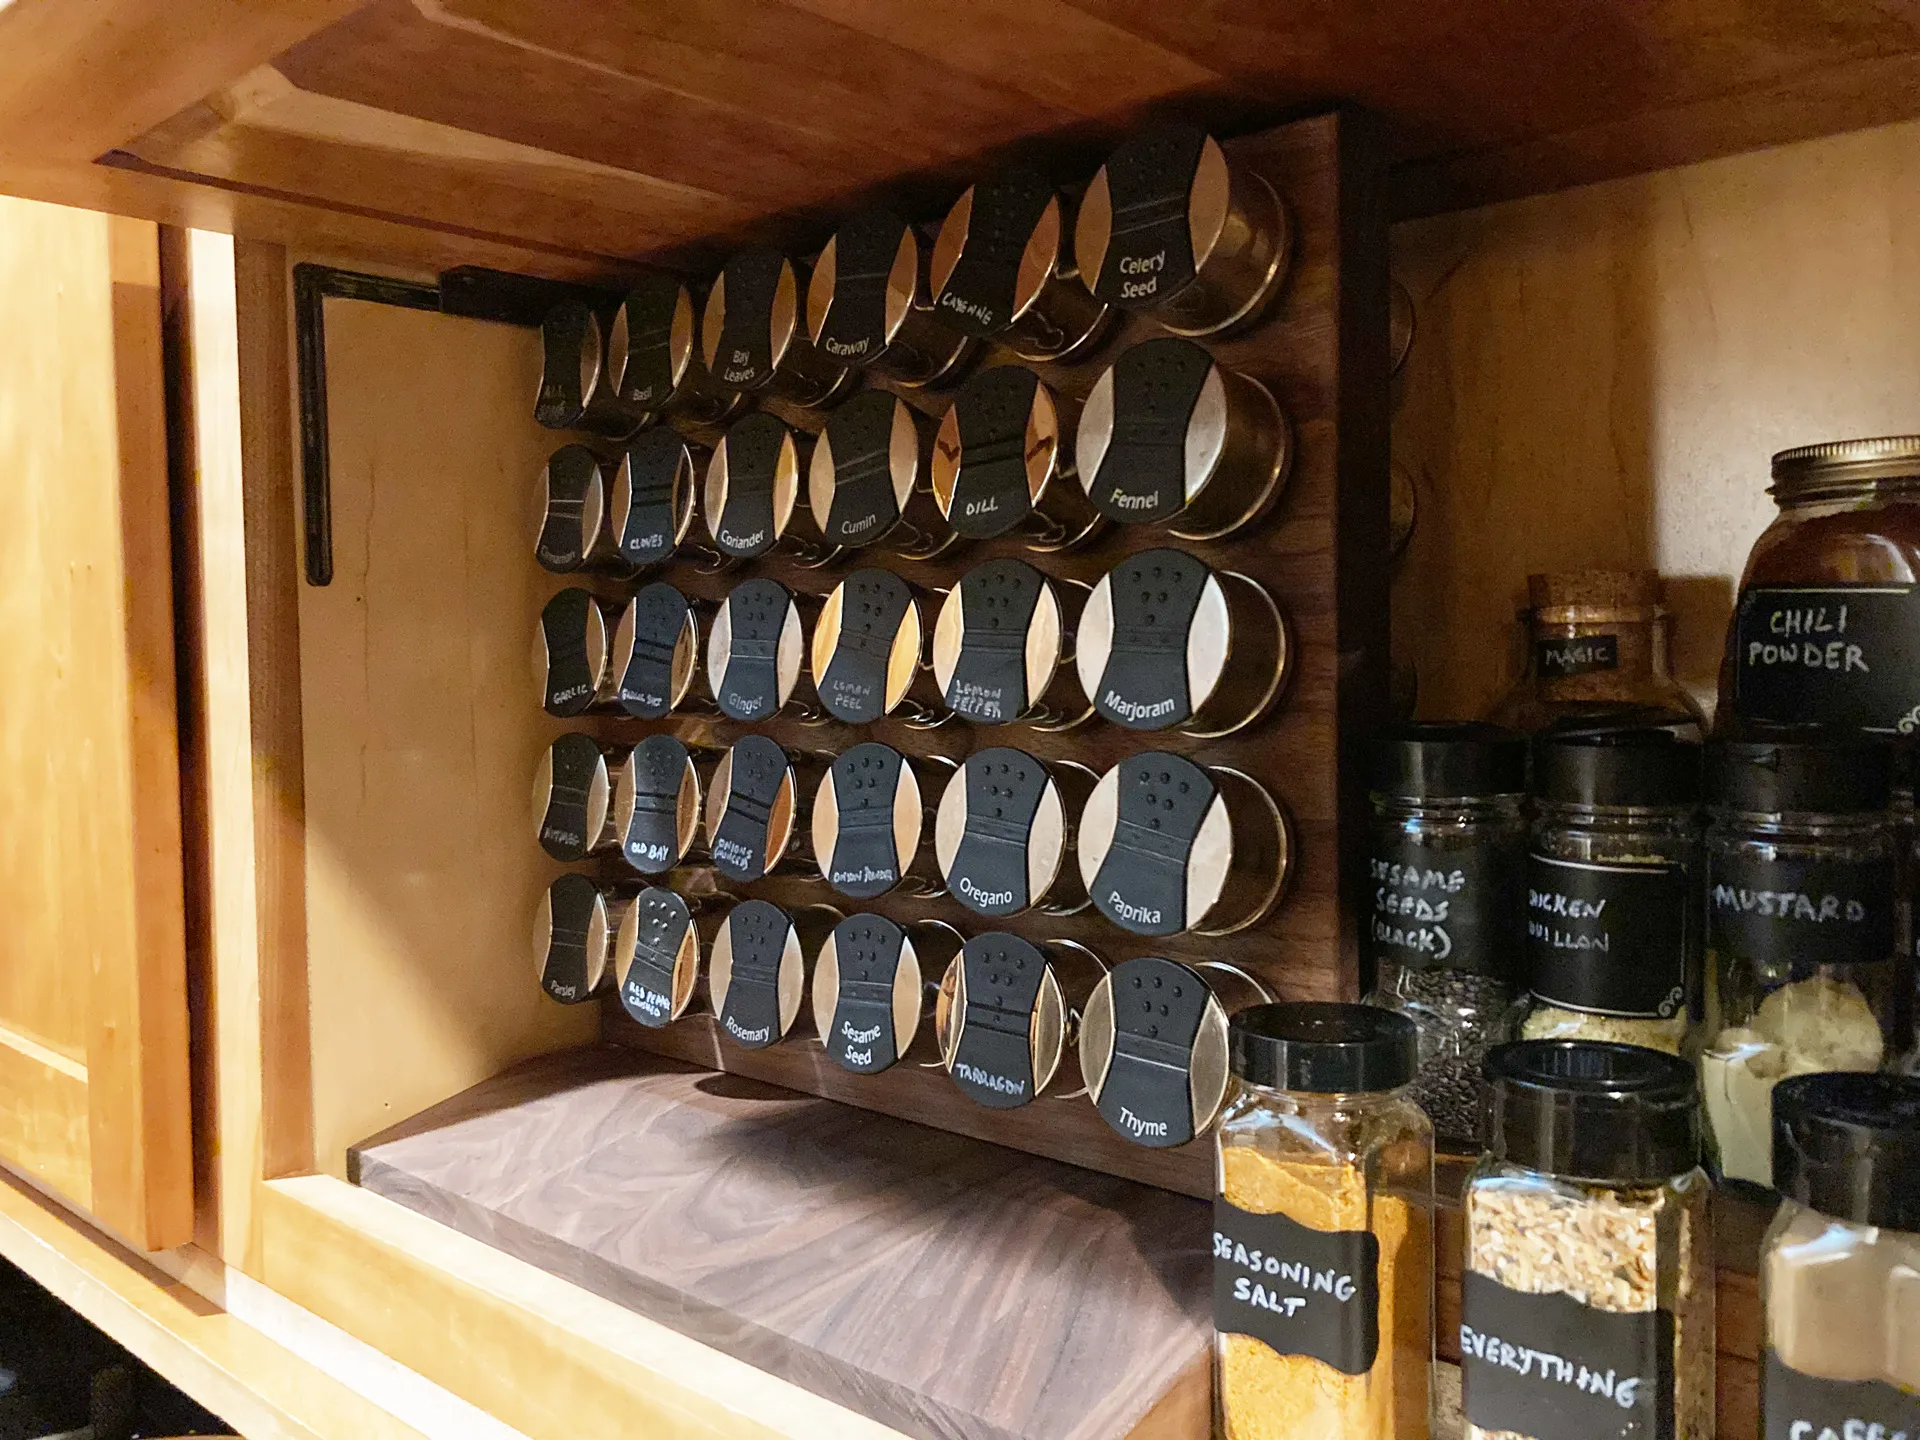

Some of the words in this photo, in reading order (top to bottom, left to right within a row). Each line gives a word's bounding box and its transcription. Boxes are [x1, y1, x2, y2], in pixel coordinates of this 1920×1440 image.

[1120, 250, 1165, 274] Celery
[1120, 276, 1156, 298] Seed
[826, 337, 869, 356] Caraway
[733, 350, 750, 366] Bay
[724, 367, 754, 382] Leaves
[633, 386, 652, 401] Basil
[966, 496, 998, 516] DILL
[1110, 488, 1159, 510] Fennel
[841, 514, 876, 534] Cumin
[630, 534, 662, 550] CLOVES
[720, 529, 764, 549] Coriander
[1769, 605, 1847, 638] CHILI
[1545, 647, 1609, 668] MAGIC
[1749, 641, 1870, 673] POWDER
[553, 684, 588, 704] GARLIC
[833, 679, 871, 697] LEMON
[956, 679, 1001, 698] LEMON
[728, 693, 763, 714] Ginger
[835, 693, 862, 711] PEEL
[952, 694, 1002, 718] PEPPER
[1104, 690, 1175, 722] Marjoram
[631, 841, 647, 854] OLD
[647, 844, 668, 861] BAY
[960, 877, 1012, 908] Oregano
[1712, 883, 1865, 923] MUSTARD
[1107, 891, 1161, 923] Paprika
[1376, 887, 1449, 921] SEEDS
[550, 980, 577, 999] Parsley
[629, 981, 645, 999] RED
[726, 1015, 769, 1042] Rosemary
[841, 1021, 881, 1044] Sesame
[844, 1044, 872, 1066] Seed
[955, 1062, 1025, 1095] TARRAGON
[1120, 1106, 1167, 1137] Thyme
[1213, 1231, 1357, 1302] SEASONING
[1233, 1277, 1307, 1318] SALT
[1460, 1323, 1641, 1408] EVERYTHING
